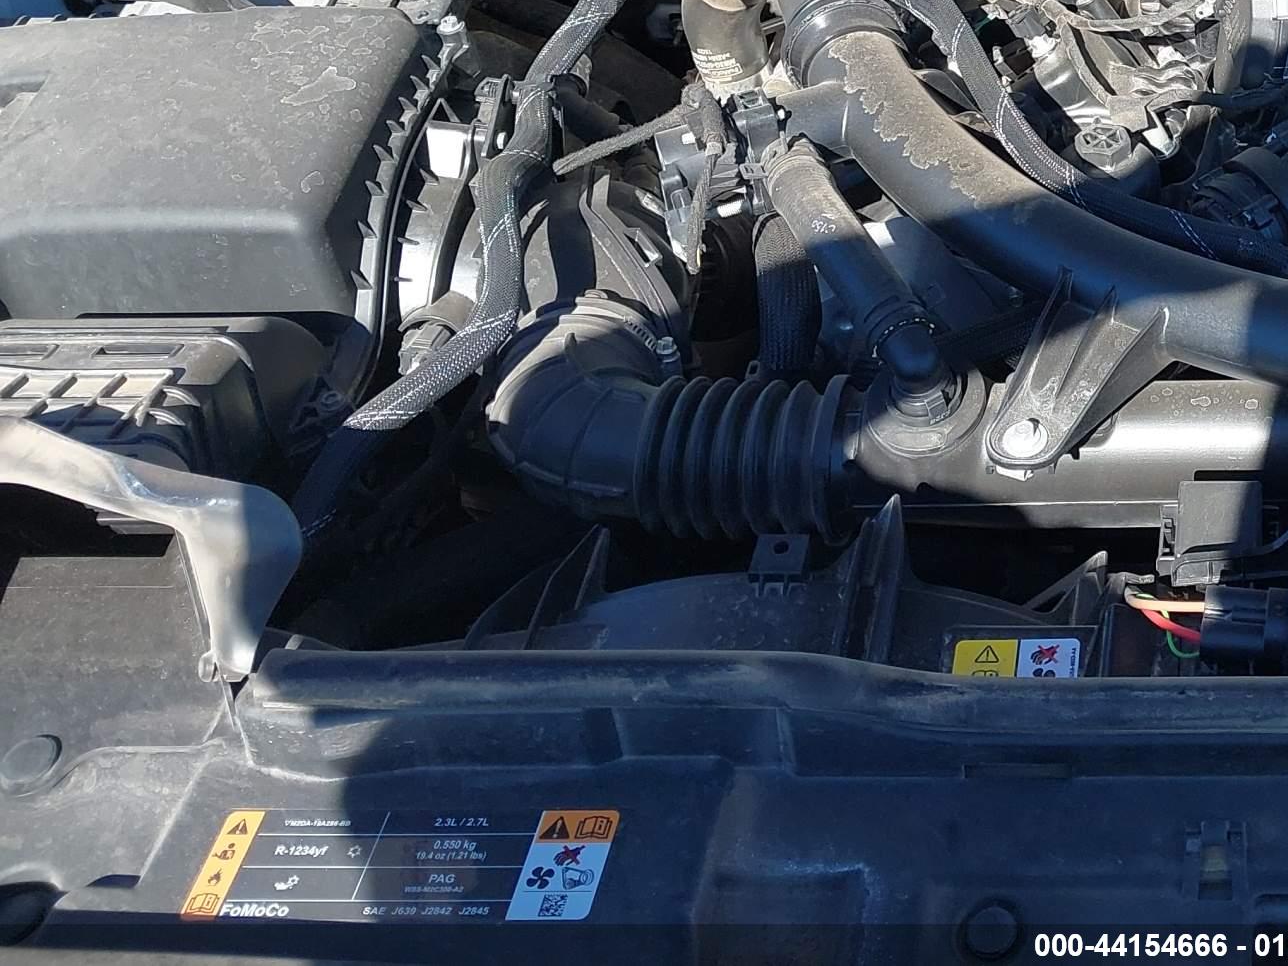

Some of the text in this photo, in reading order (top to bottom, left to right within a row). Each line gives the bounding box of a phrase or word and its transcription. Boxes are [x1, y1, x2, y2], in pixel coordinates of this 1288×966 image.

[434, 818, 489, 827] 2.3L / 2.7L
[433, 839, 477, 851] 0.550 kg
[274, 845, 329, 858] R-1234yf
[416, 851, 434, 859] 19.4
[447, 851, 469, 861] (1.21
[469, 851, 487, 861] lbs)
[428, 874, 457, 883] PAG
[219, 903, 289, 917] FoMoCo
[362, 906, 490, 915] SAE J639 J2842 J2845
